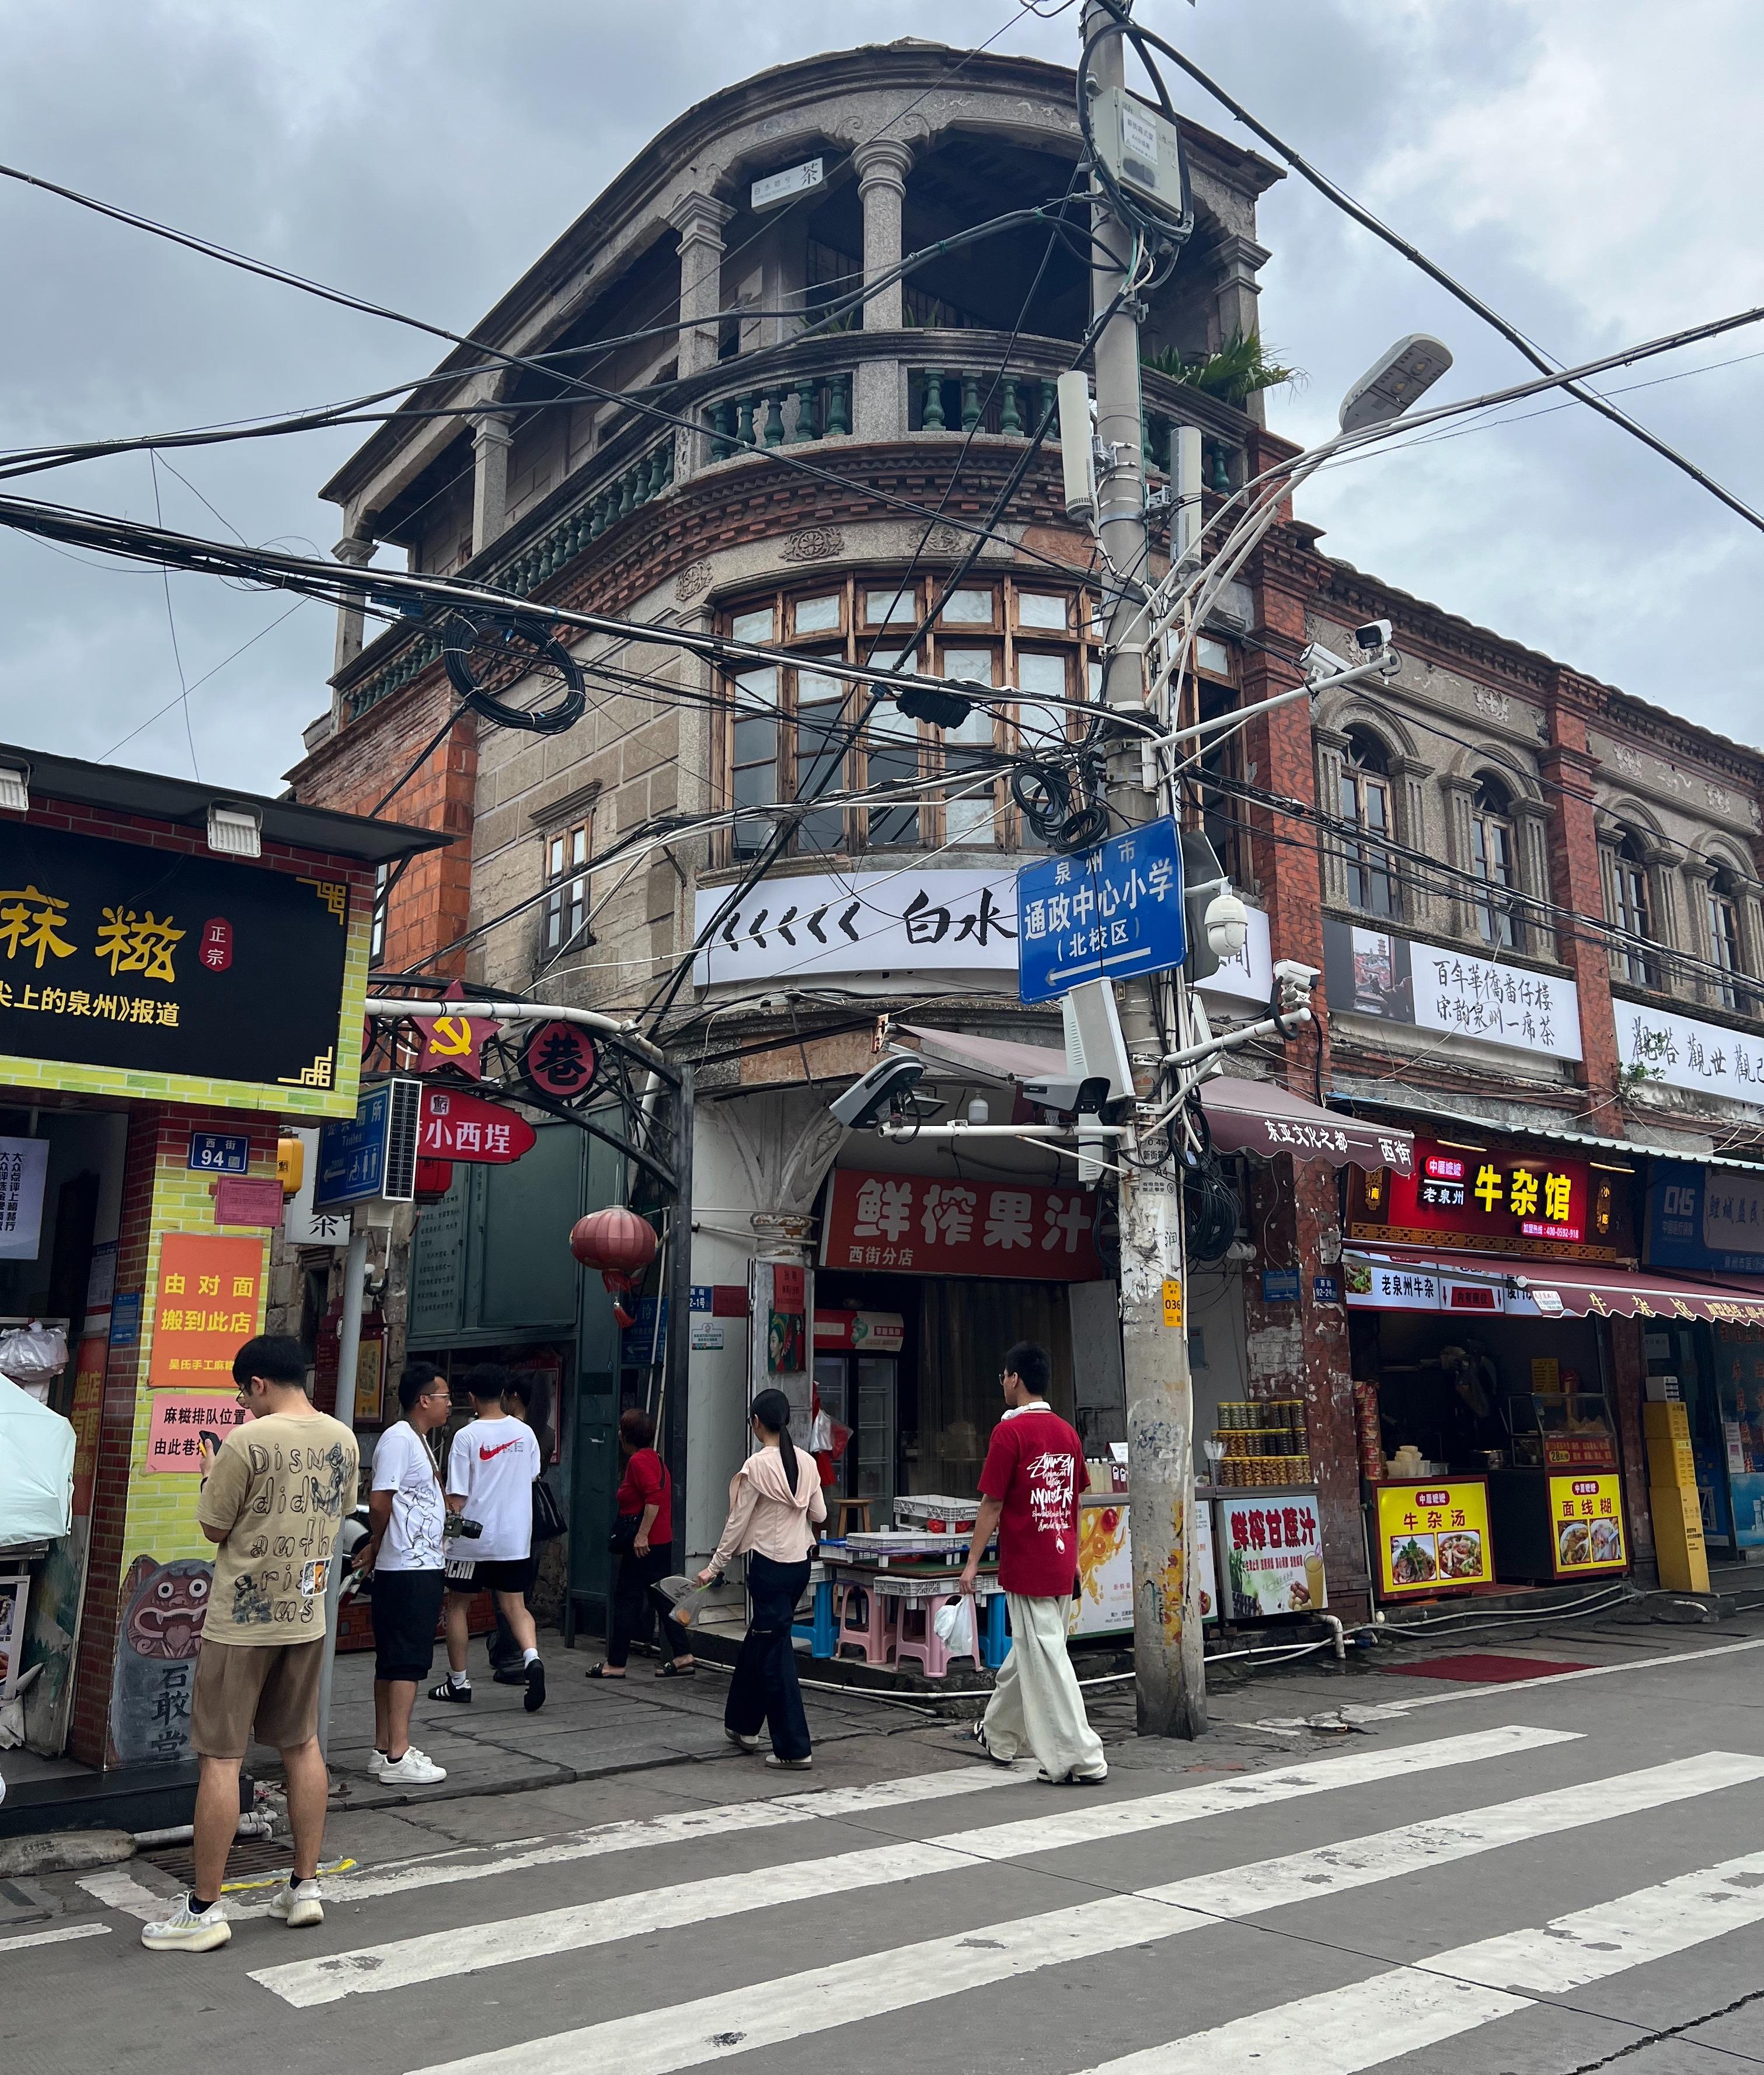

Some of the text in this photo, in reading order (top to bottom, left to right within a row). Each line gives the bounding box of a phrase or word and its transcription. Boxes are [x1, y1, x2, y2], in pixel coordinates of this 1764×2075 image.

[1055, 839, 1136, 885] 泉州市
[1024, 857, 1174, 941] 通政中心小学
[902, 888, 1018, 946] 白水
[206, 926, 226, 966] 正宗
[534, 1032, 587, 1086] 巷
[205, 1138, 236, 1150] 西街
[201, 1149, 224, 1166] 94
[1423, 1187, 1464, 1205] 老泉州
[1474, 1163, 1571, 1221] 牛杂馆
[853, 1178, 1092, 1253] 鲜榨果汁
[849, 1246, 914, 1266] 西街分店
[165, 1272, 255, 1298] 由对面
[690, 1288, 705, 1296] 西街
[1381, 1274, 1434, 1298] 老泉州牛杂
[161, 1309, 252, 1334] 搬到此店
[163, 1407, 246, 1425] 麻糍排队位置
[1403, 1509, 1466, 1530] 牛杂汤
[1562, 1498, 1612, 1517] 面线糊
[1230, 1506, 1316, 1551] 鲜榨甘蔗汁
